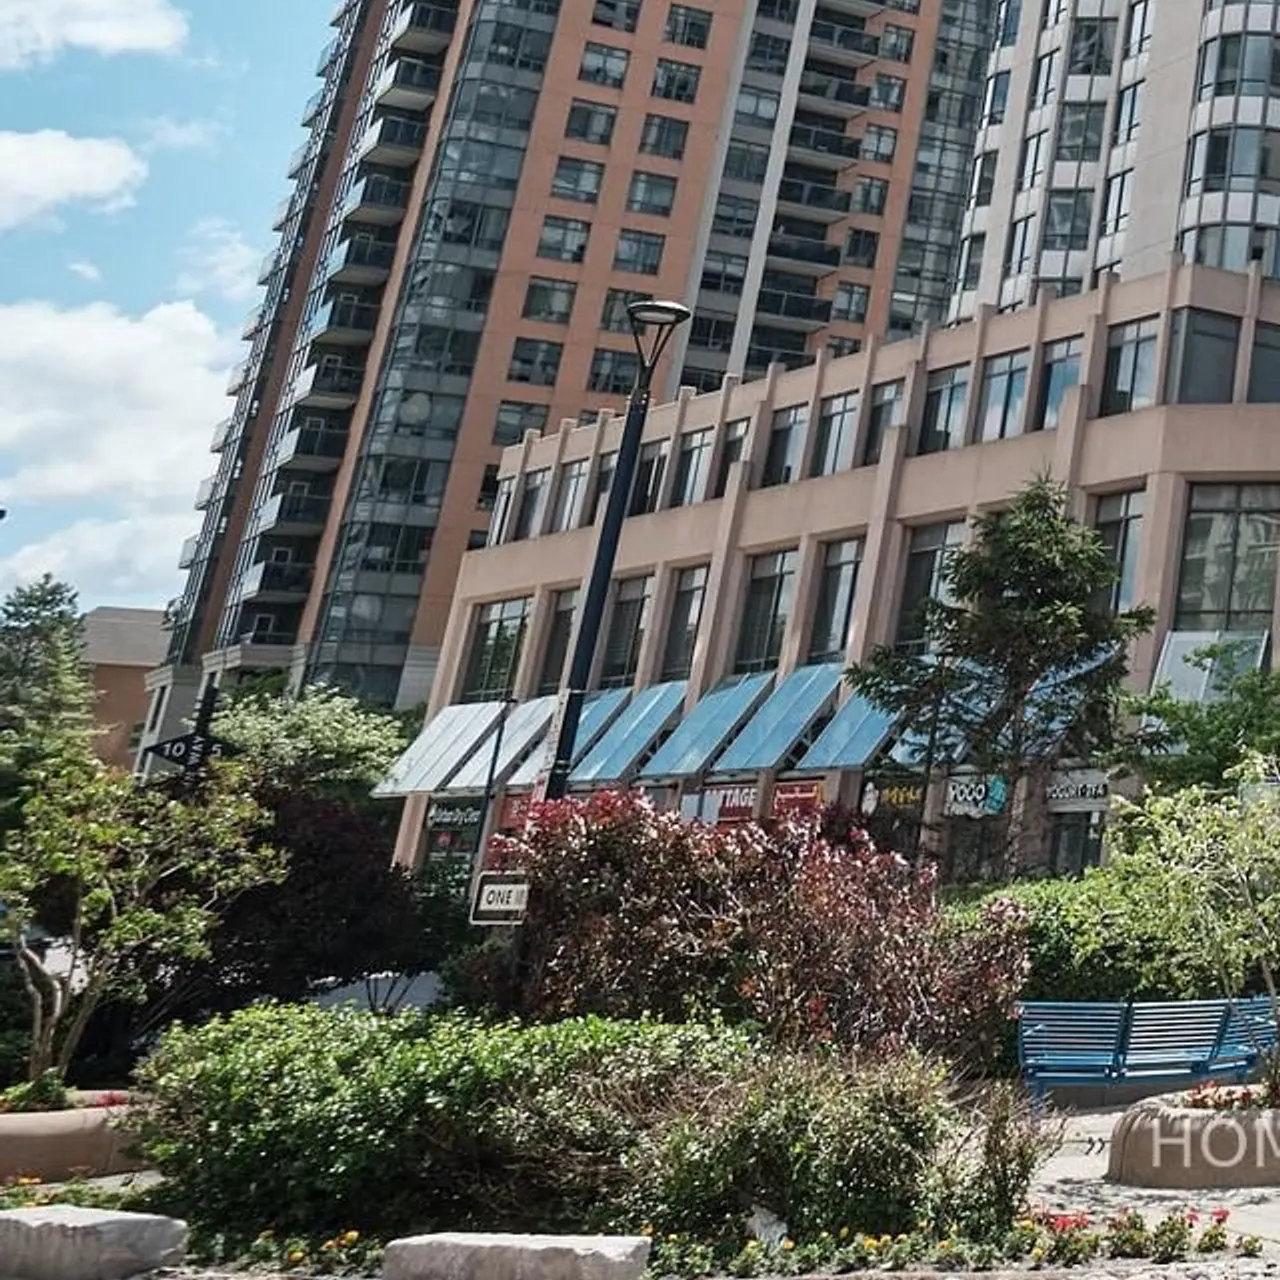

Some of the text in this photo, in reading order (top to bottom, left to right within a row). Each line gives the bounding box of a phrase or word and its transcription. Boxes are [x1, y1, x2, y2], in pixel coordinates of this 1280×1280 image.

[163, 742, 186, 757] 10
[704, 787, 758, 807] TTAGE
[486, 888, 513, 905] ONE
